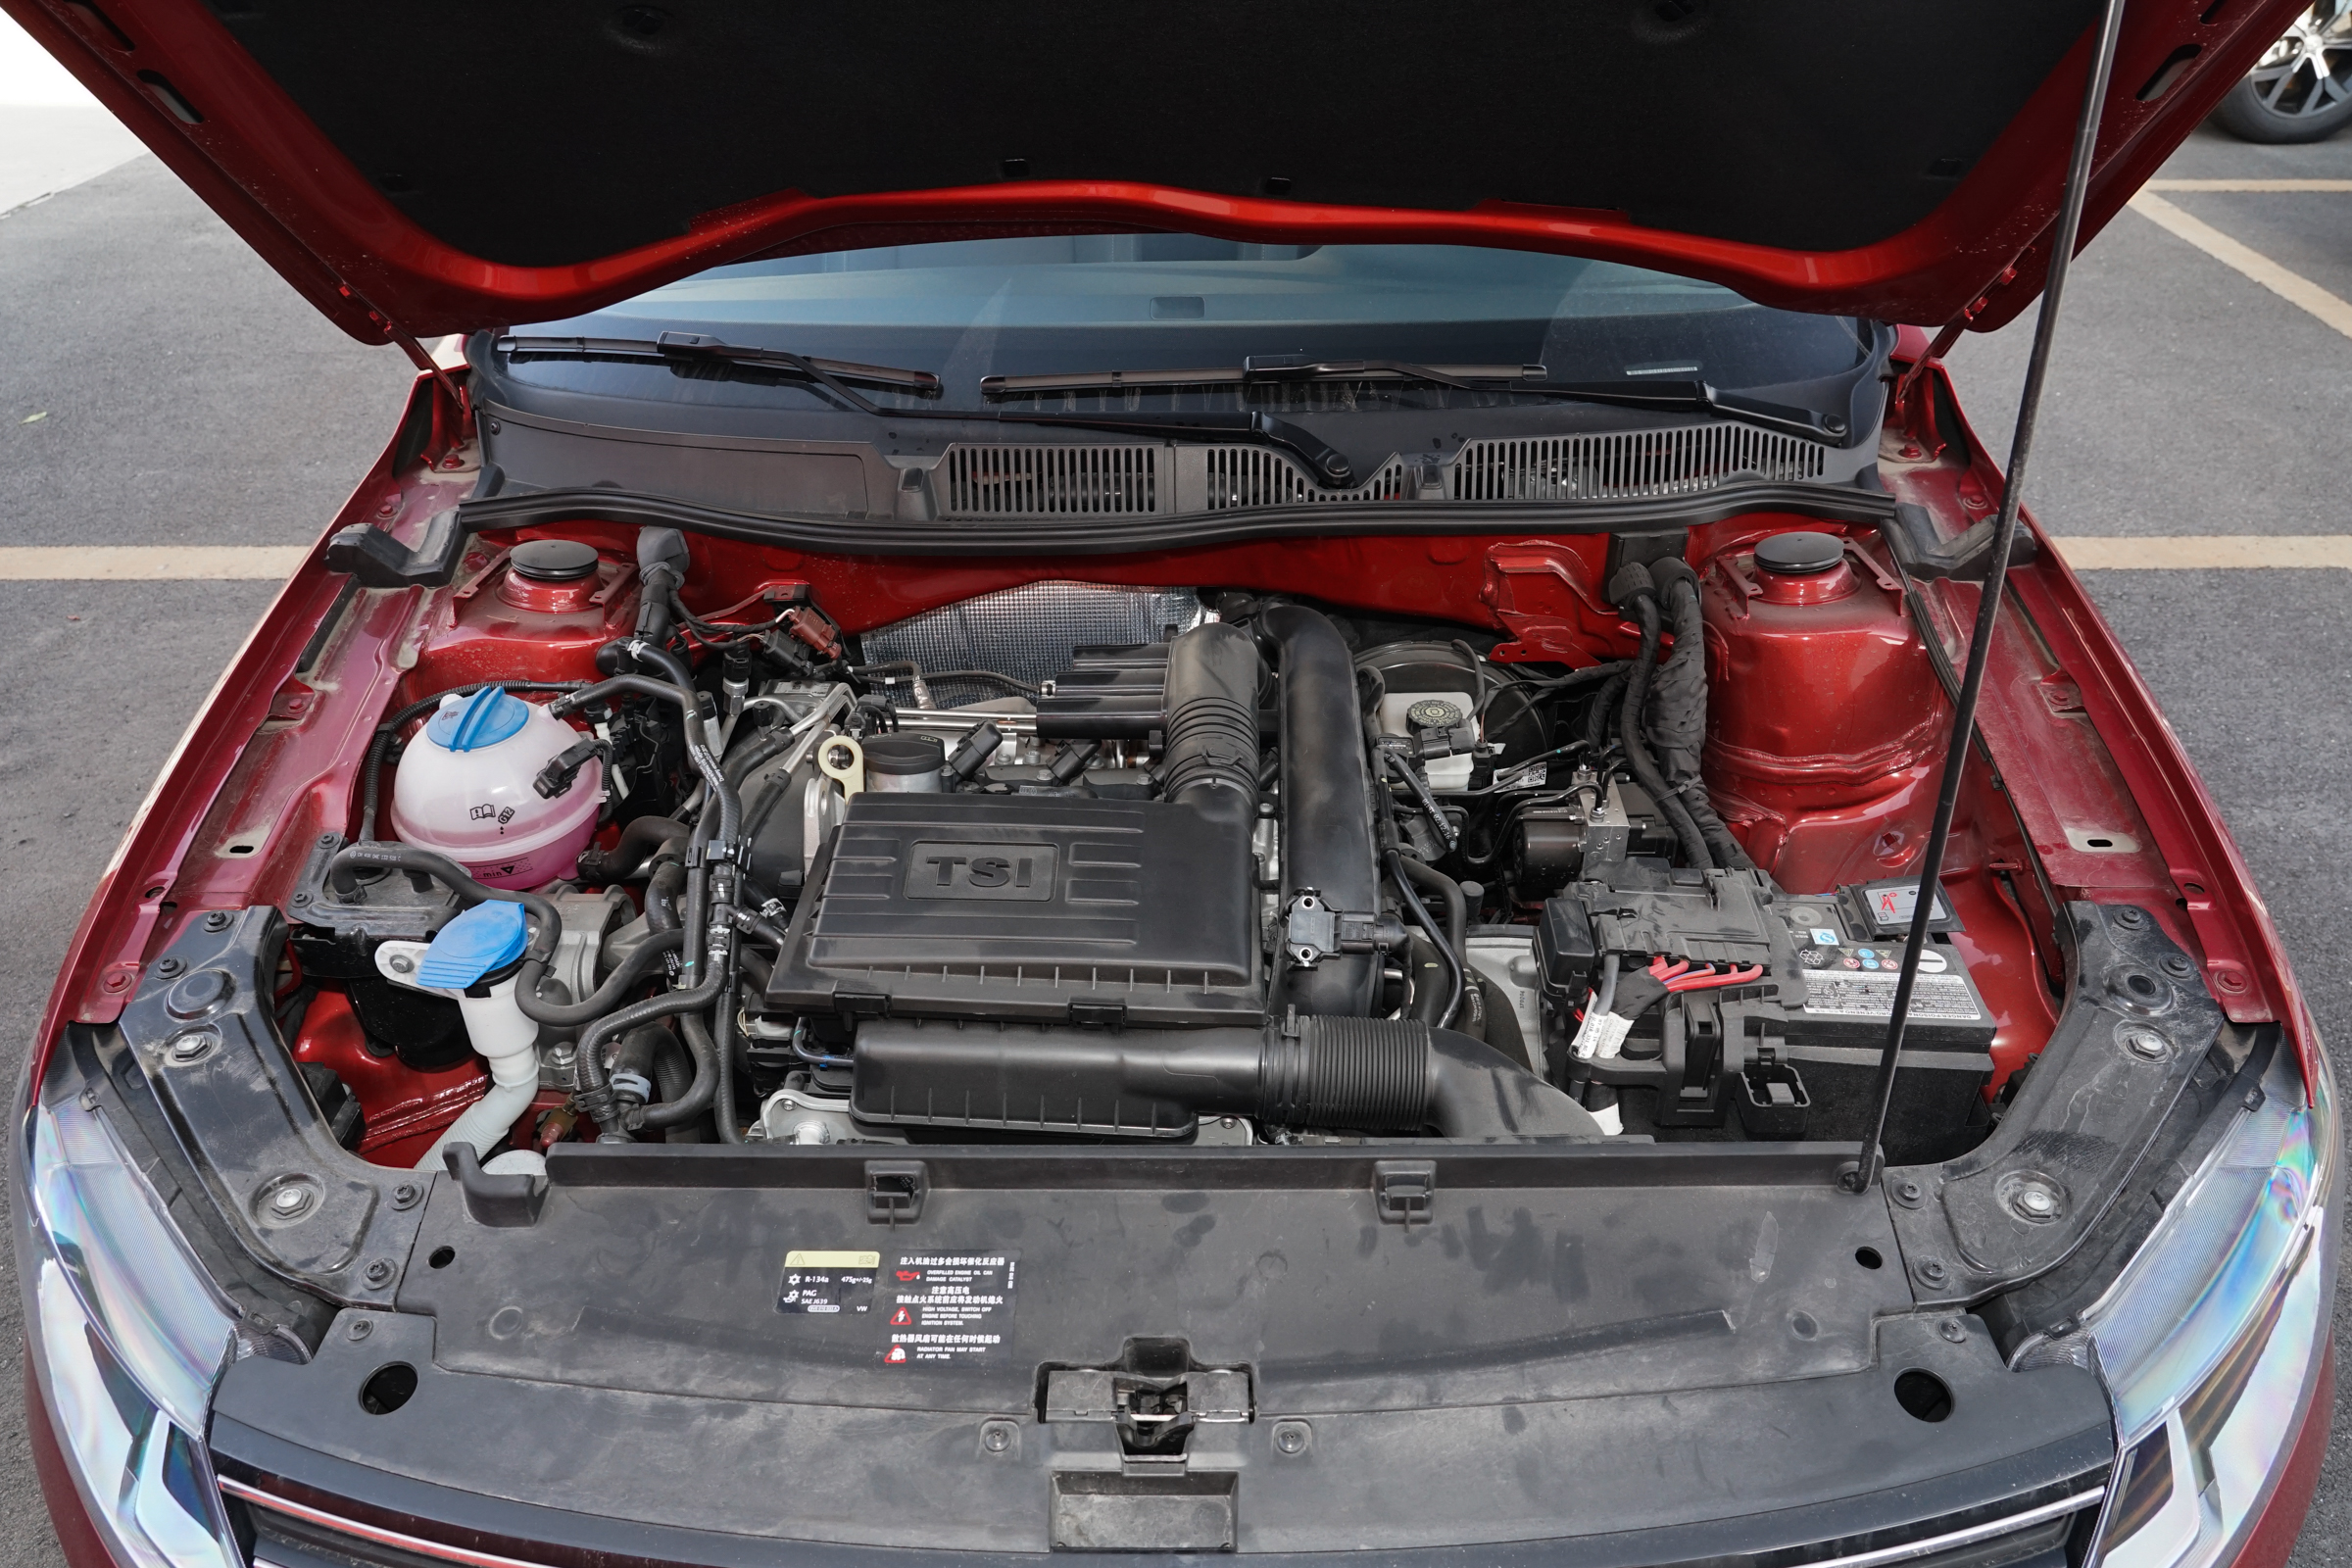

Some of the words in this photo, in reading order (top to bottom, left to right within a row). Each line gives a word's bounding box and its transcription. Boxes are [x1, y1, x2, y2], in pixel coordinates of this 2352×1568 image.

[498, 807, 515, 823] G12
[926, 856, 1034, 888] TSI
[900, 1256, 1005, 1266] 注入机油过多会损坏催化反应器
[931, 1286, 970, 1295] 注意高压电
[896, 1295, 1004, 1304] 接触点火系统前应将发动机熄火
[891, 1334, 1001, 1344] 散热器风扇可能在任何时候起动
